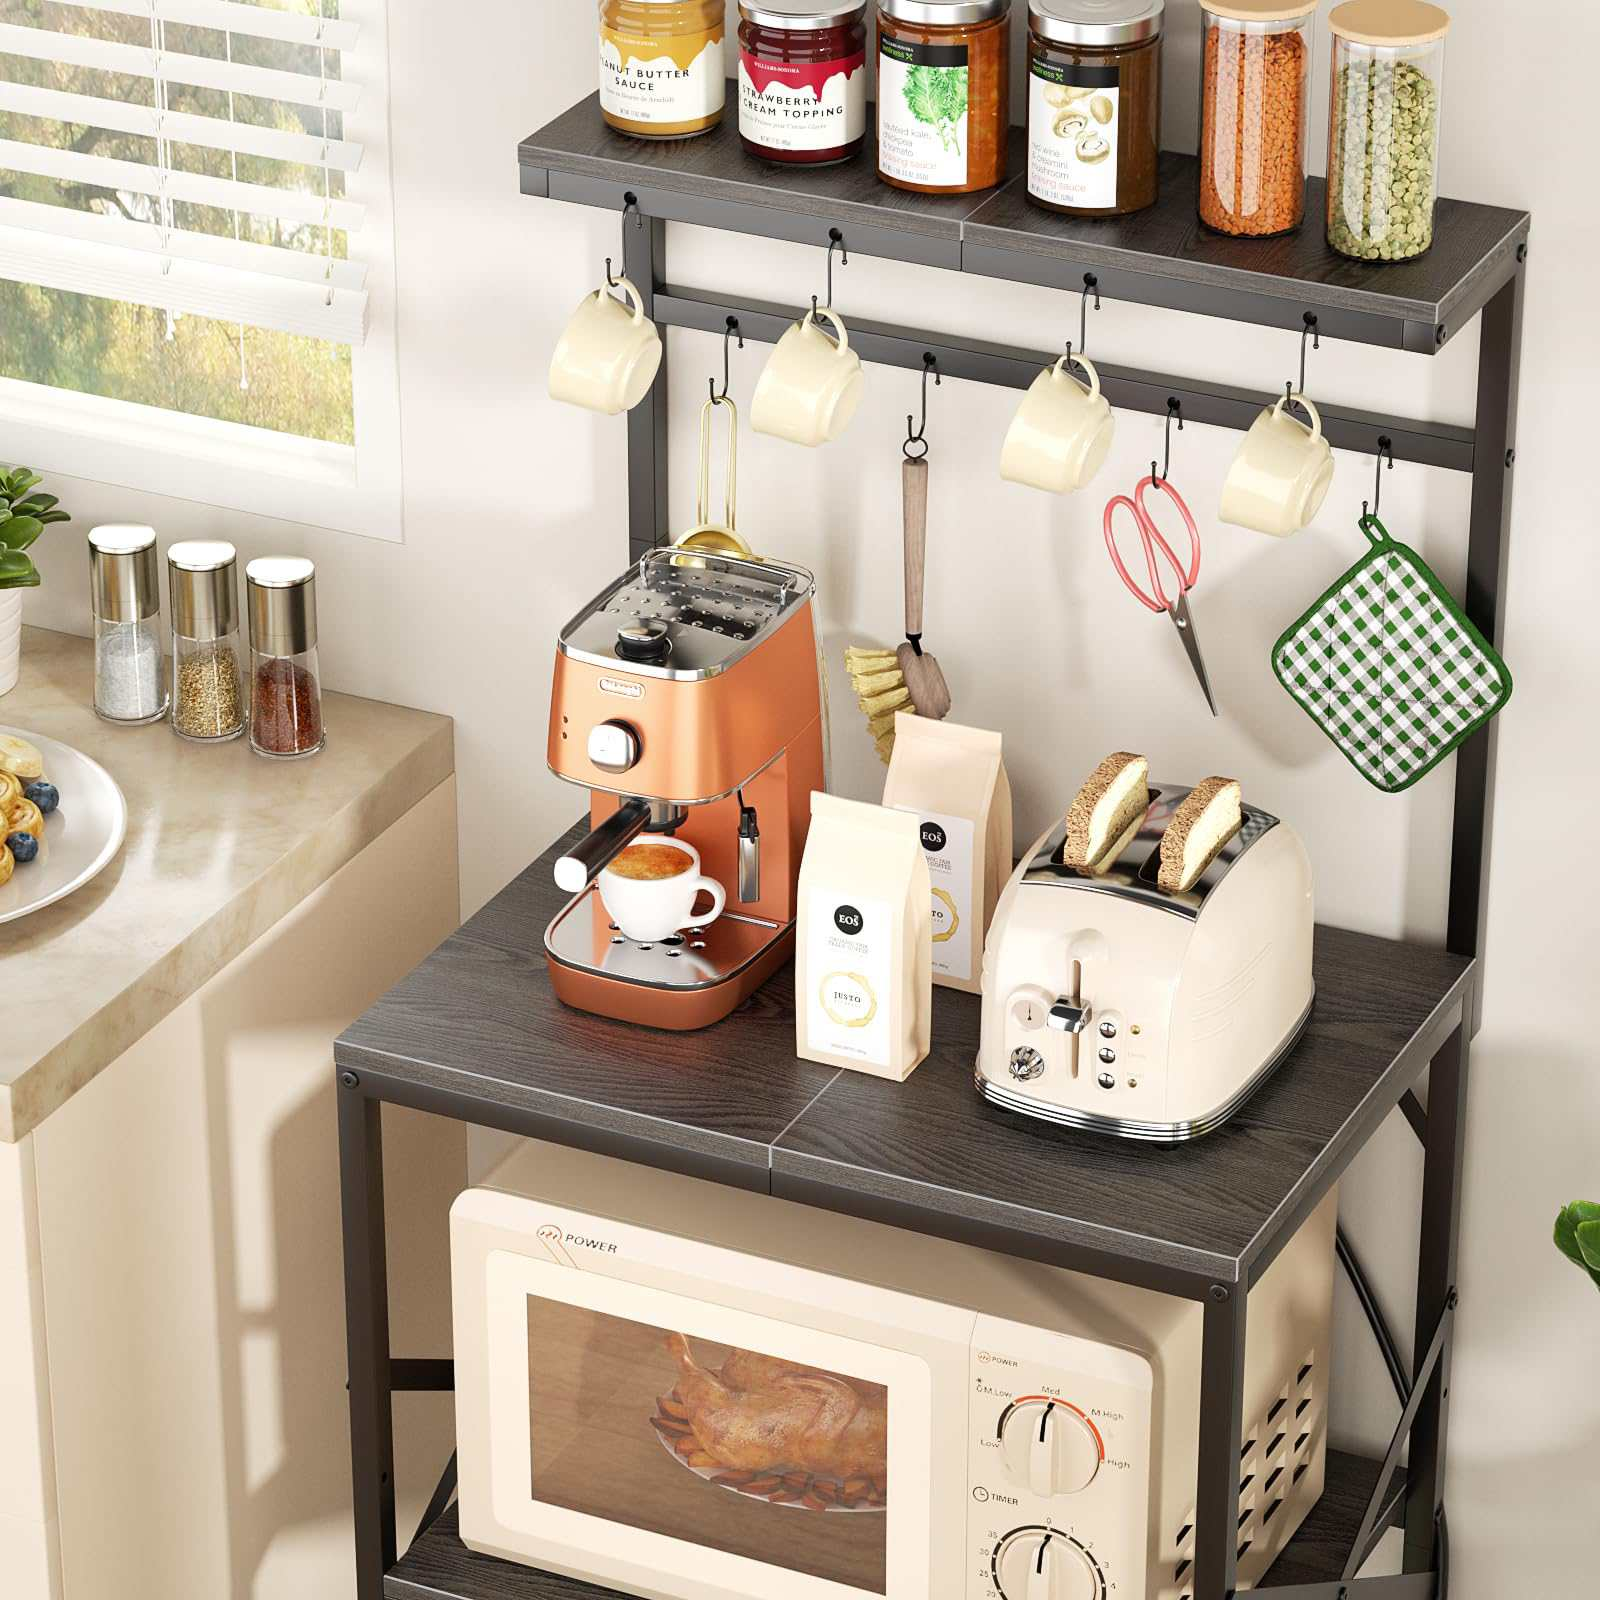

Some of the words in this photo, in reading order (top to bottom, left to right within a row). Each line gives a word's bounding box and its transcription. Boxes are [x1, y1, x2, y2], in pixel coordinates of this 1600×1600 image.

[636, 69, 690, 79] BUTTER
[615, 77, 654, 91] SAUCE
[742, 84, 818, 106] STRAWBERRY
[743, 98, 776, 116] CREAM
[783, 106, 843, 119] TOPPING
[565, 1233, 618, 1254] POWER
[992, 1356, 1018, 1368] POWER
[1041, 1385, 1060, 1396] Med
[980, 1439, 1000, 1448] Low
[1107, 1459, 1130, 1469] High
[991, 1493, 1018, 1506] TIMER
[1046, 1516, 1052, 1525] 0
